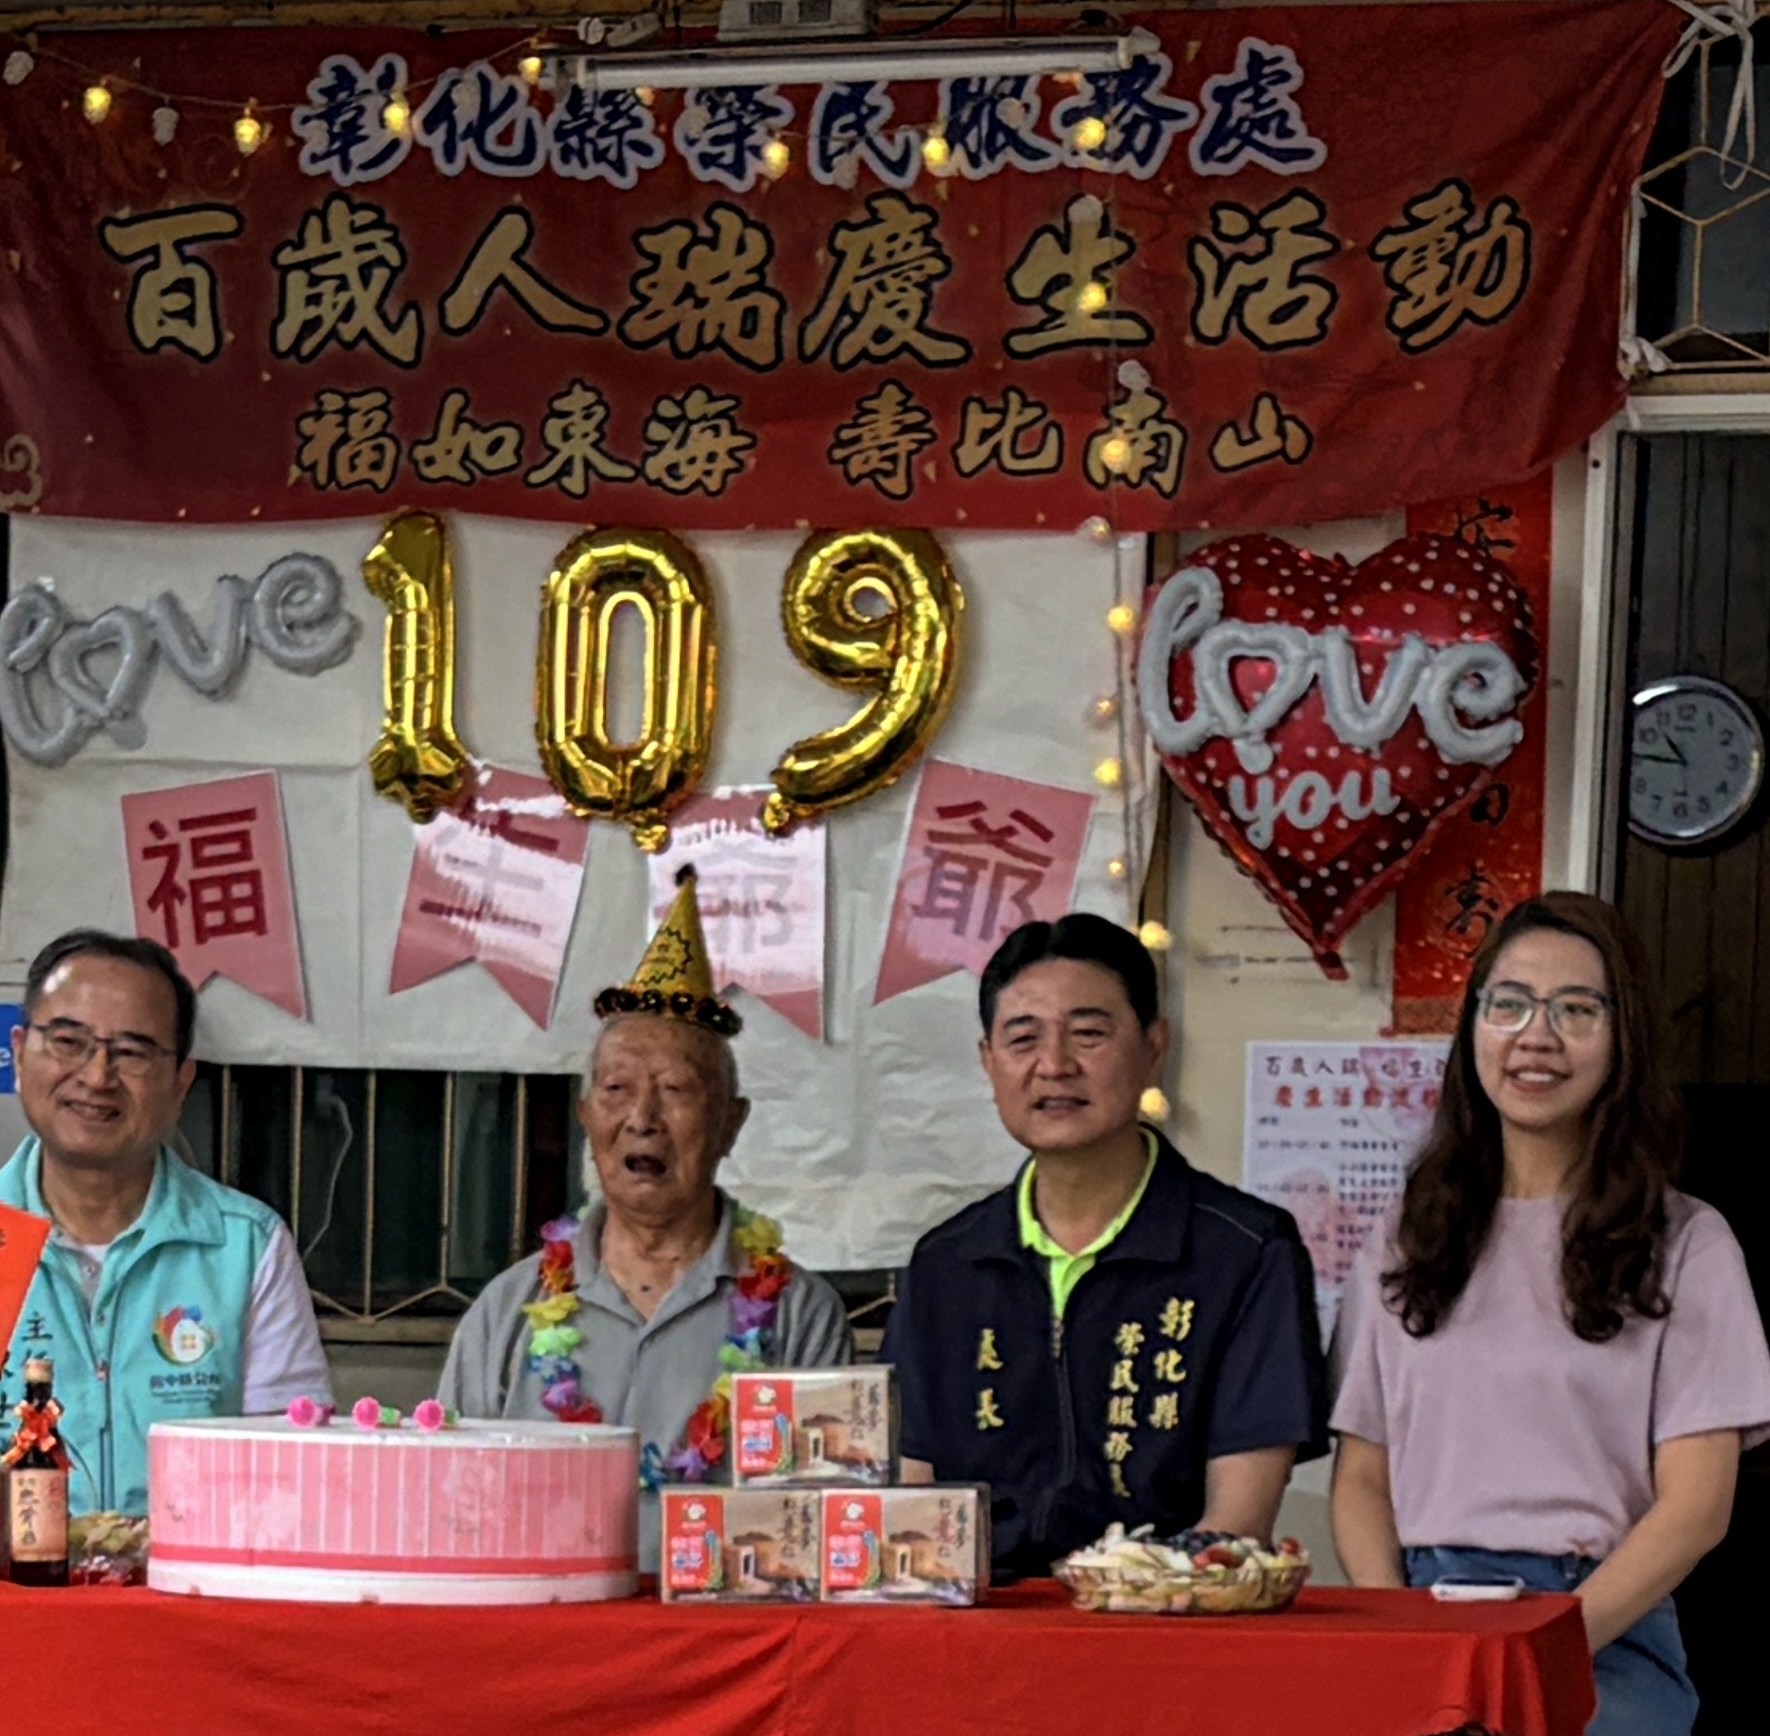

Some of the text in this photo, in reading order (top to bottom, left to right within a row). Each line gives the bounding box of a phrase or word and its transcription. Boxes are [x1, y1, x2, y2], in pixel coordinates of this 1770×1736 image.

[293, 38, 1326, 190] 彰化縣榮民服務處
[100, 178, 1532, 370] 百歲人瑞慶生活動
[296, 380, 1314, 499] 福如東海 壽比南山
[361, 508, 967, 838] 109
[142, 806, 268, 948] 福
[912, 797, 1058, 942] 爺
[1232, 764, 1400, 850] you
